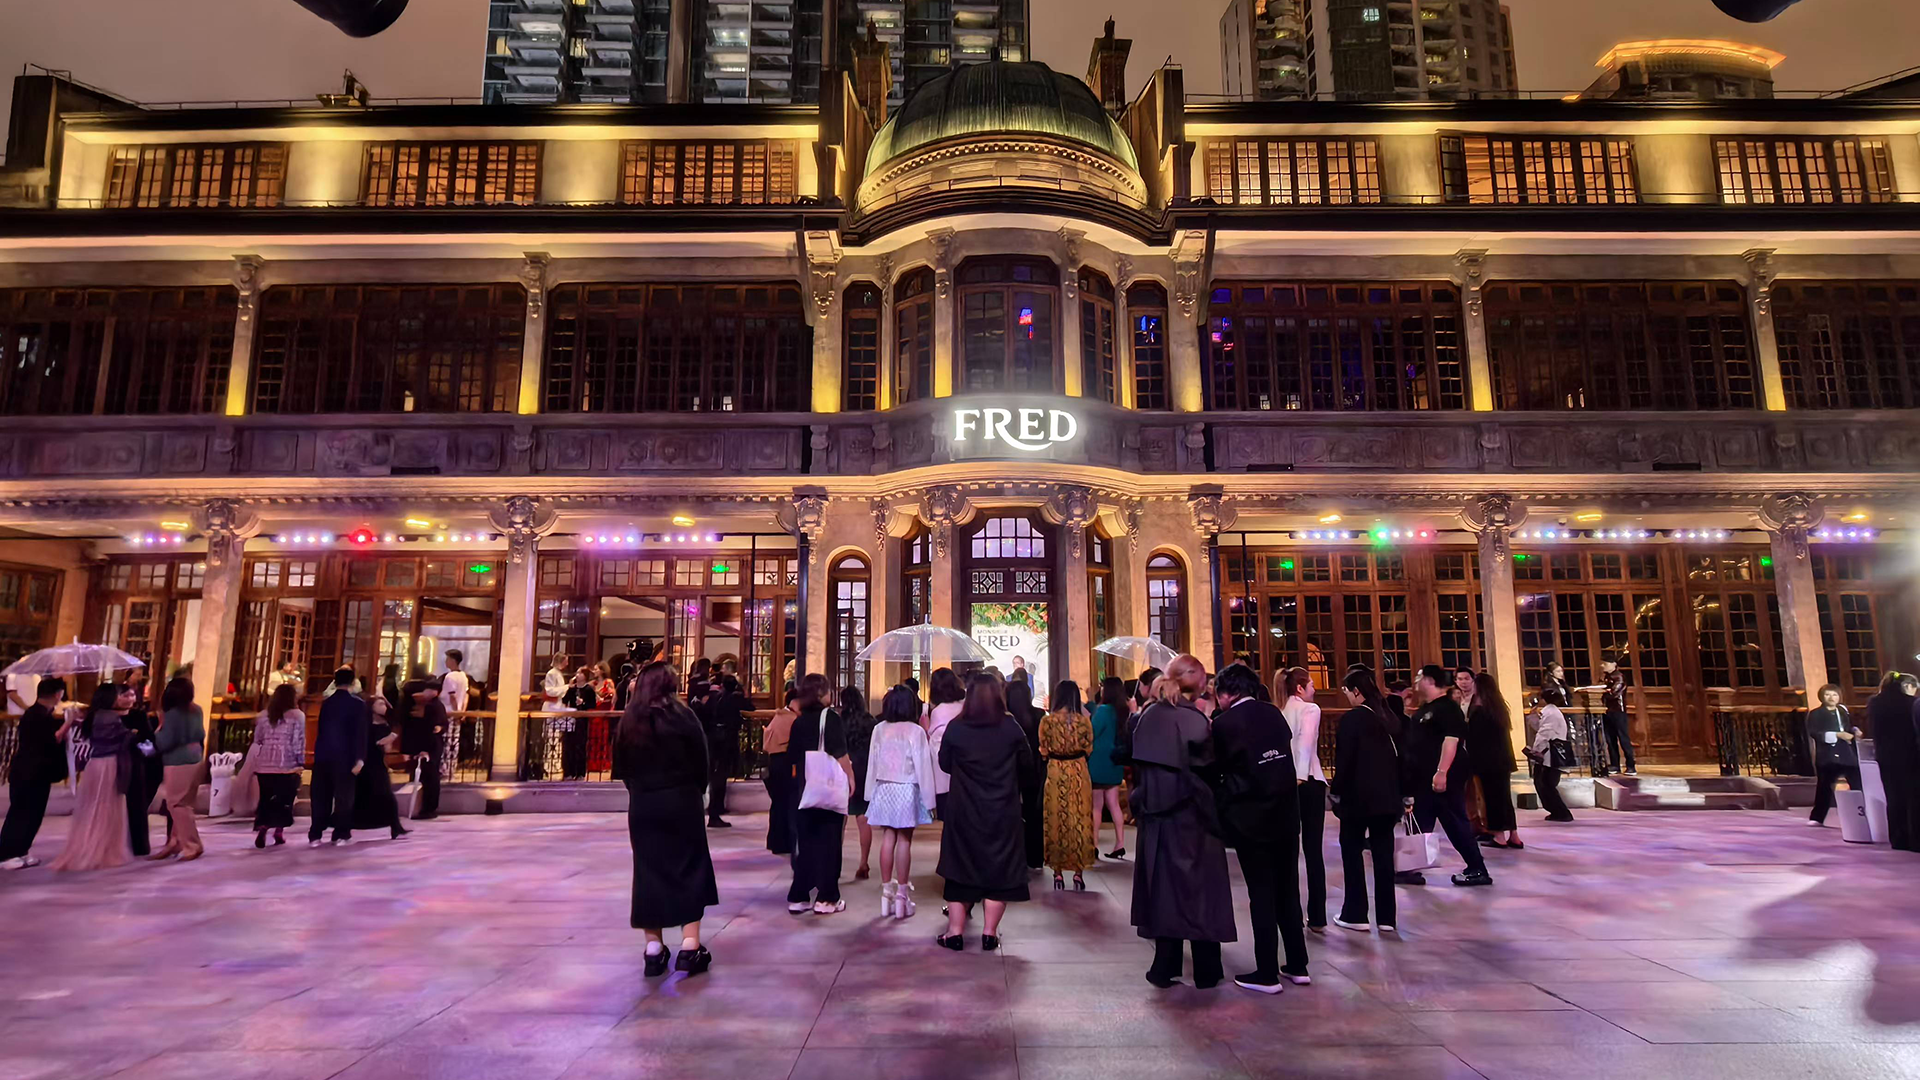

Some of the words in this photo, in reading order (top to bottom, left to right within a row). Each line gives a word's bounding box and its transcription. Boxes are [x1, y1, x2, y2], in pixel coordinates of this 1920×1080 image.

[954, 408, 1077, 451] FRED
[978, 635, 1020, 651] FRED
[1857, 805, 1866, 817] 3
